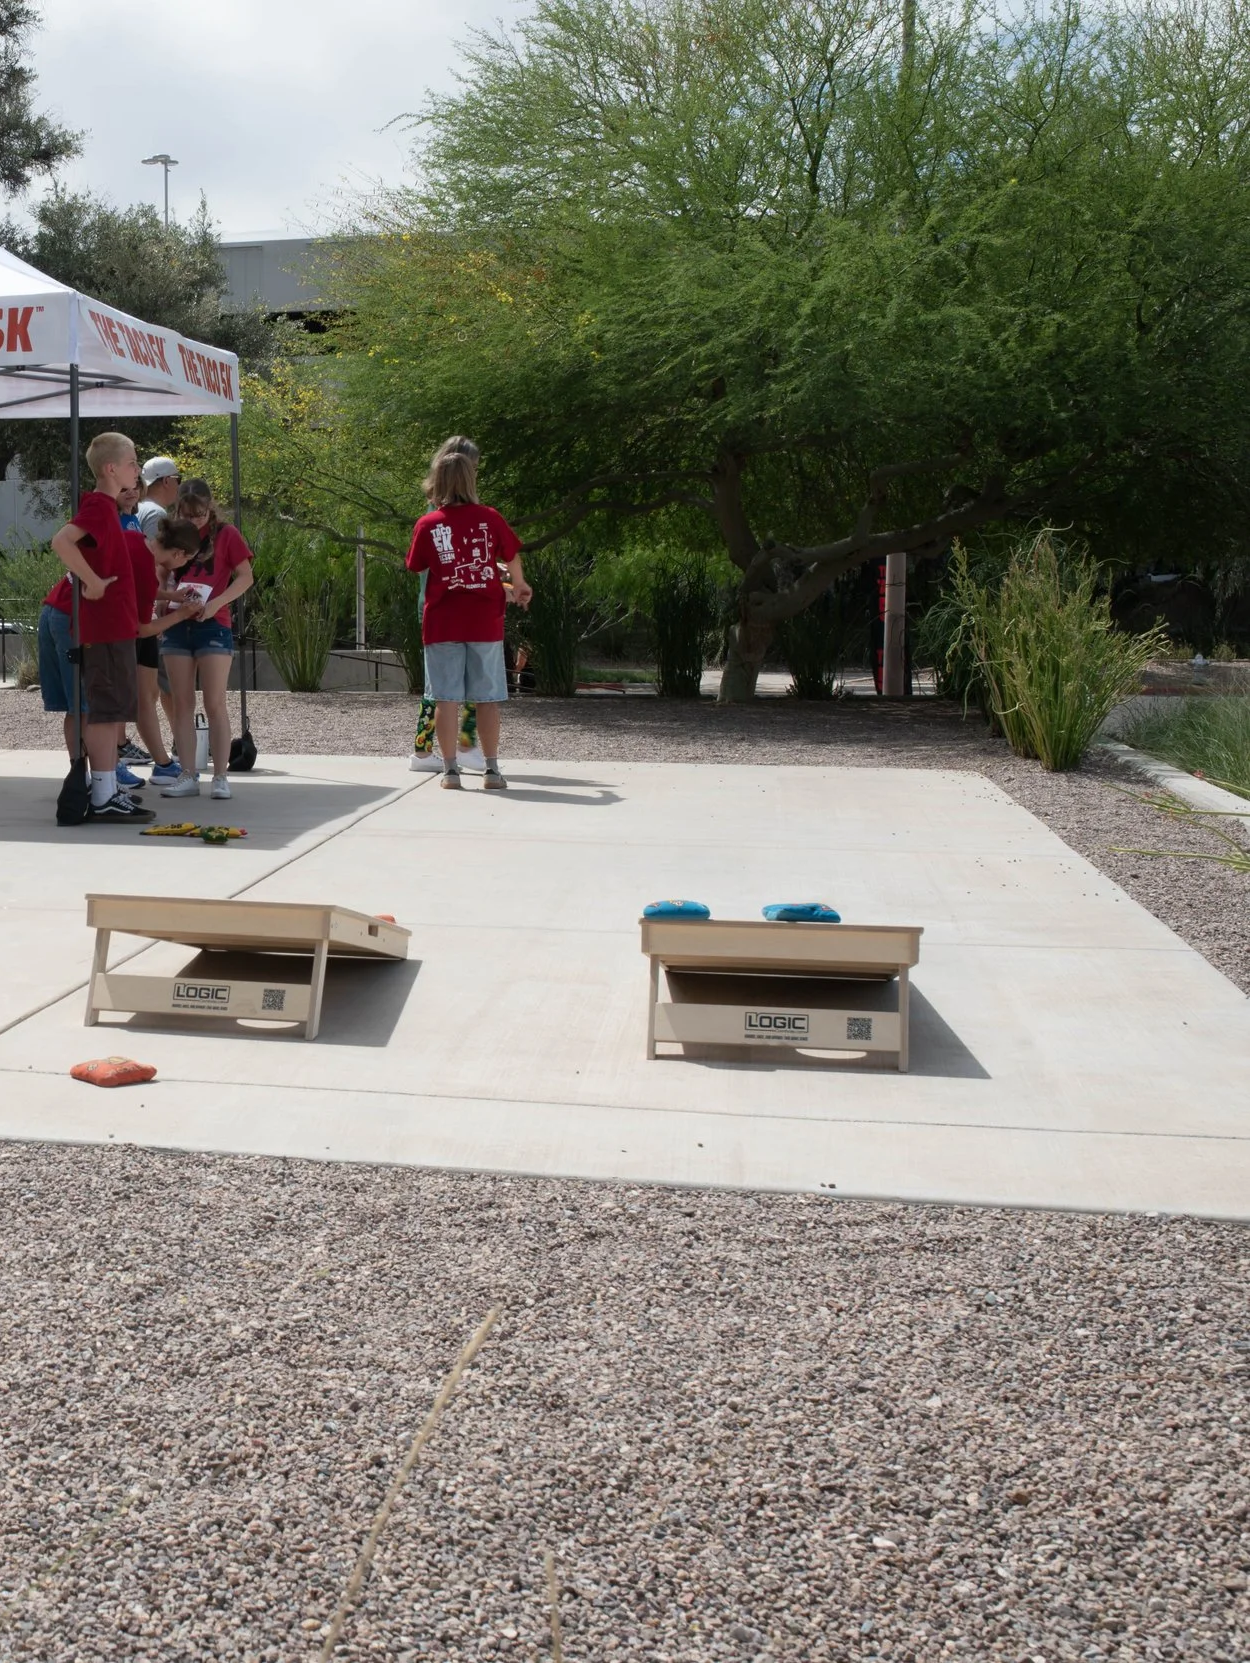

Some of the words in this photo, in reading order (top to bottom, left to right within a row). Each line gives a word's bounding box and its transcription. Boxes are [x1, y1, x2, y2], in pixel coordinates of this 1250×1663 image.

[89, 310, 125, 357] THE
[116, 321, 157, 369] TACO
[177, 343, 202, 388] THE
[196, 352, 221, 396] TACO
[430, 526, 452, 538] TACO
[433, 534, 454, 552] 5K
[177, 986, 226, 999] LOGIC
[748, 1015, 805, 1029] LOGIC
